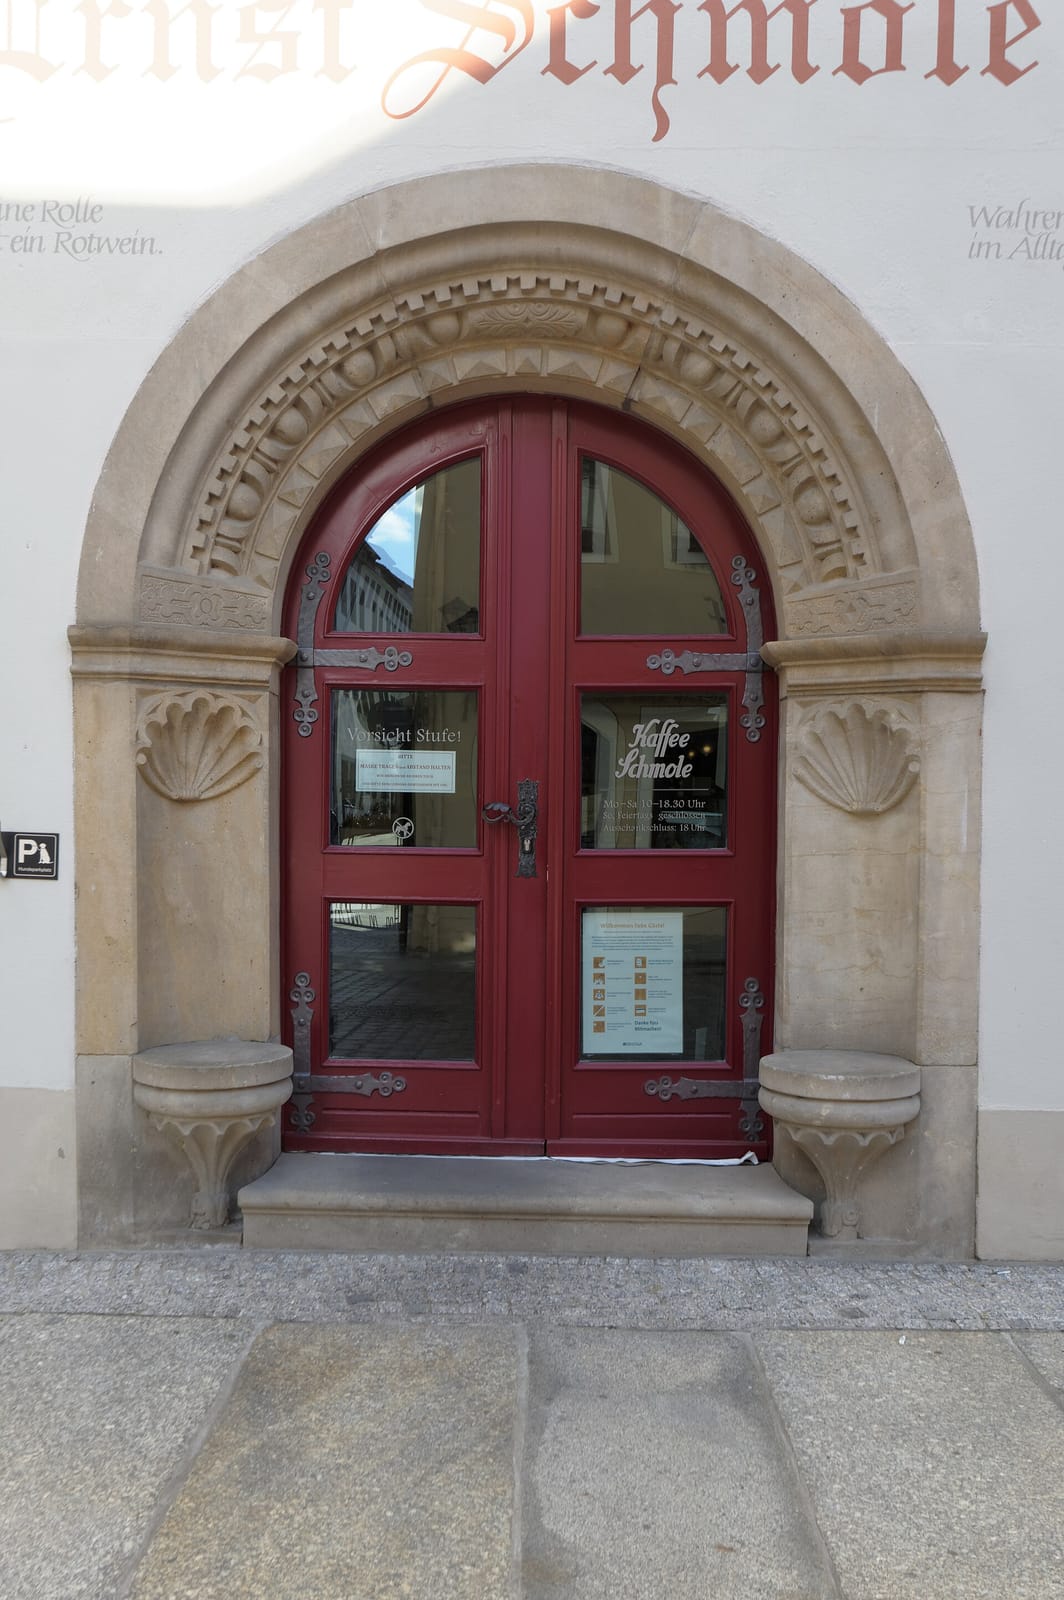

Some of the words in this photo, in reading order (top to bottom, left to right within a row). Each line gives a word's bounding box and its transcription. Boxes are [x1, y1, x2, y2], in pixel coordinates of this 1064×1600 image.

[381, 0, 1041, 142] Schmole
[41, 196, 104, 229] Rolle
[10, 226, 46, 254] ein
[54, 229, 163, 262] Rotwein.
[967, 231, 1002, 259] im
[347, 727, 410, 743] Vorsicht
[416, 728, 461, 743] Stufe!
[628, 718, 691, 758] Kaffee
[615, 748, 693, 779] Schmole
[688, 799, 706, 809] Uhr
[680, 823, 689, 832] 18
[691, 823, 705, 832] Uhr
[18, 838, 38, 864] P
